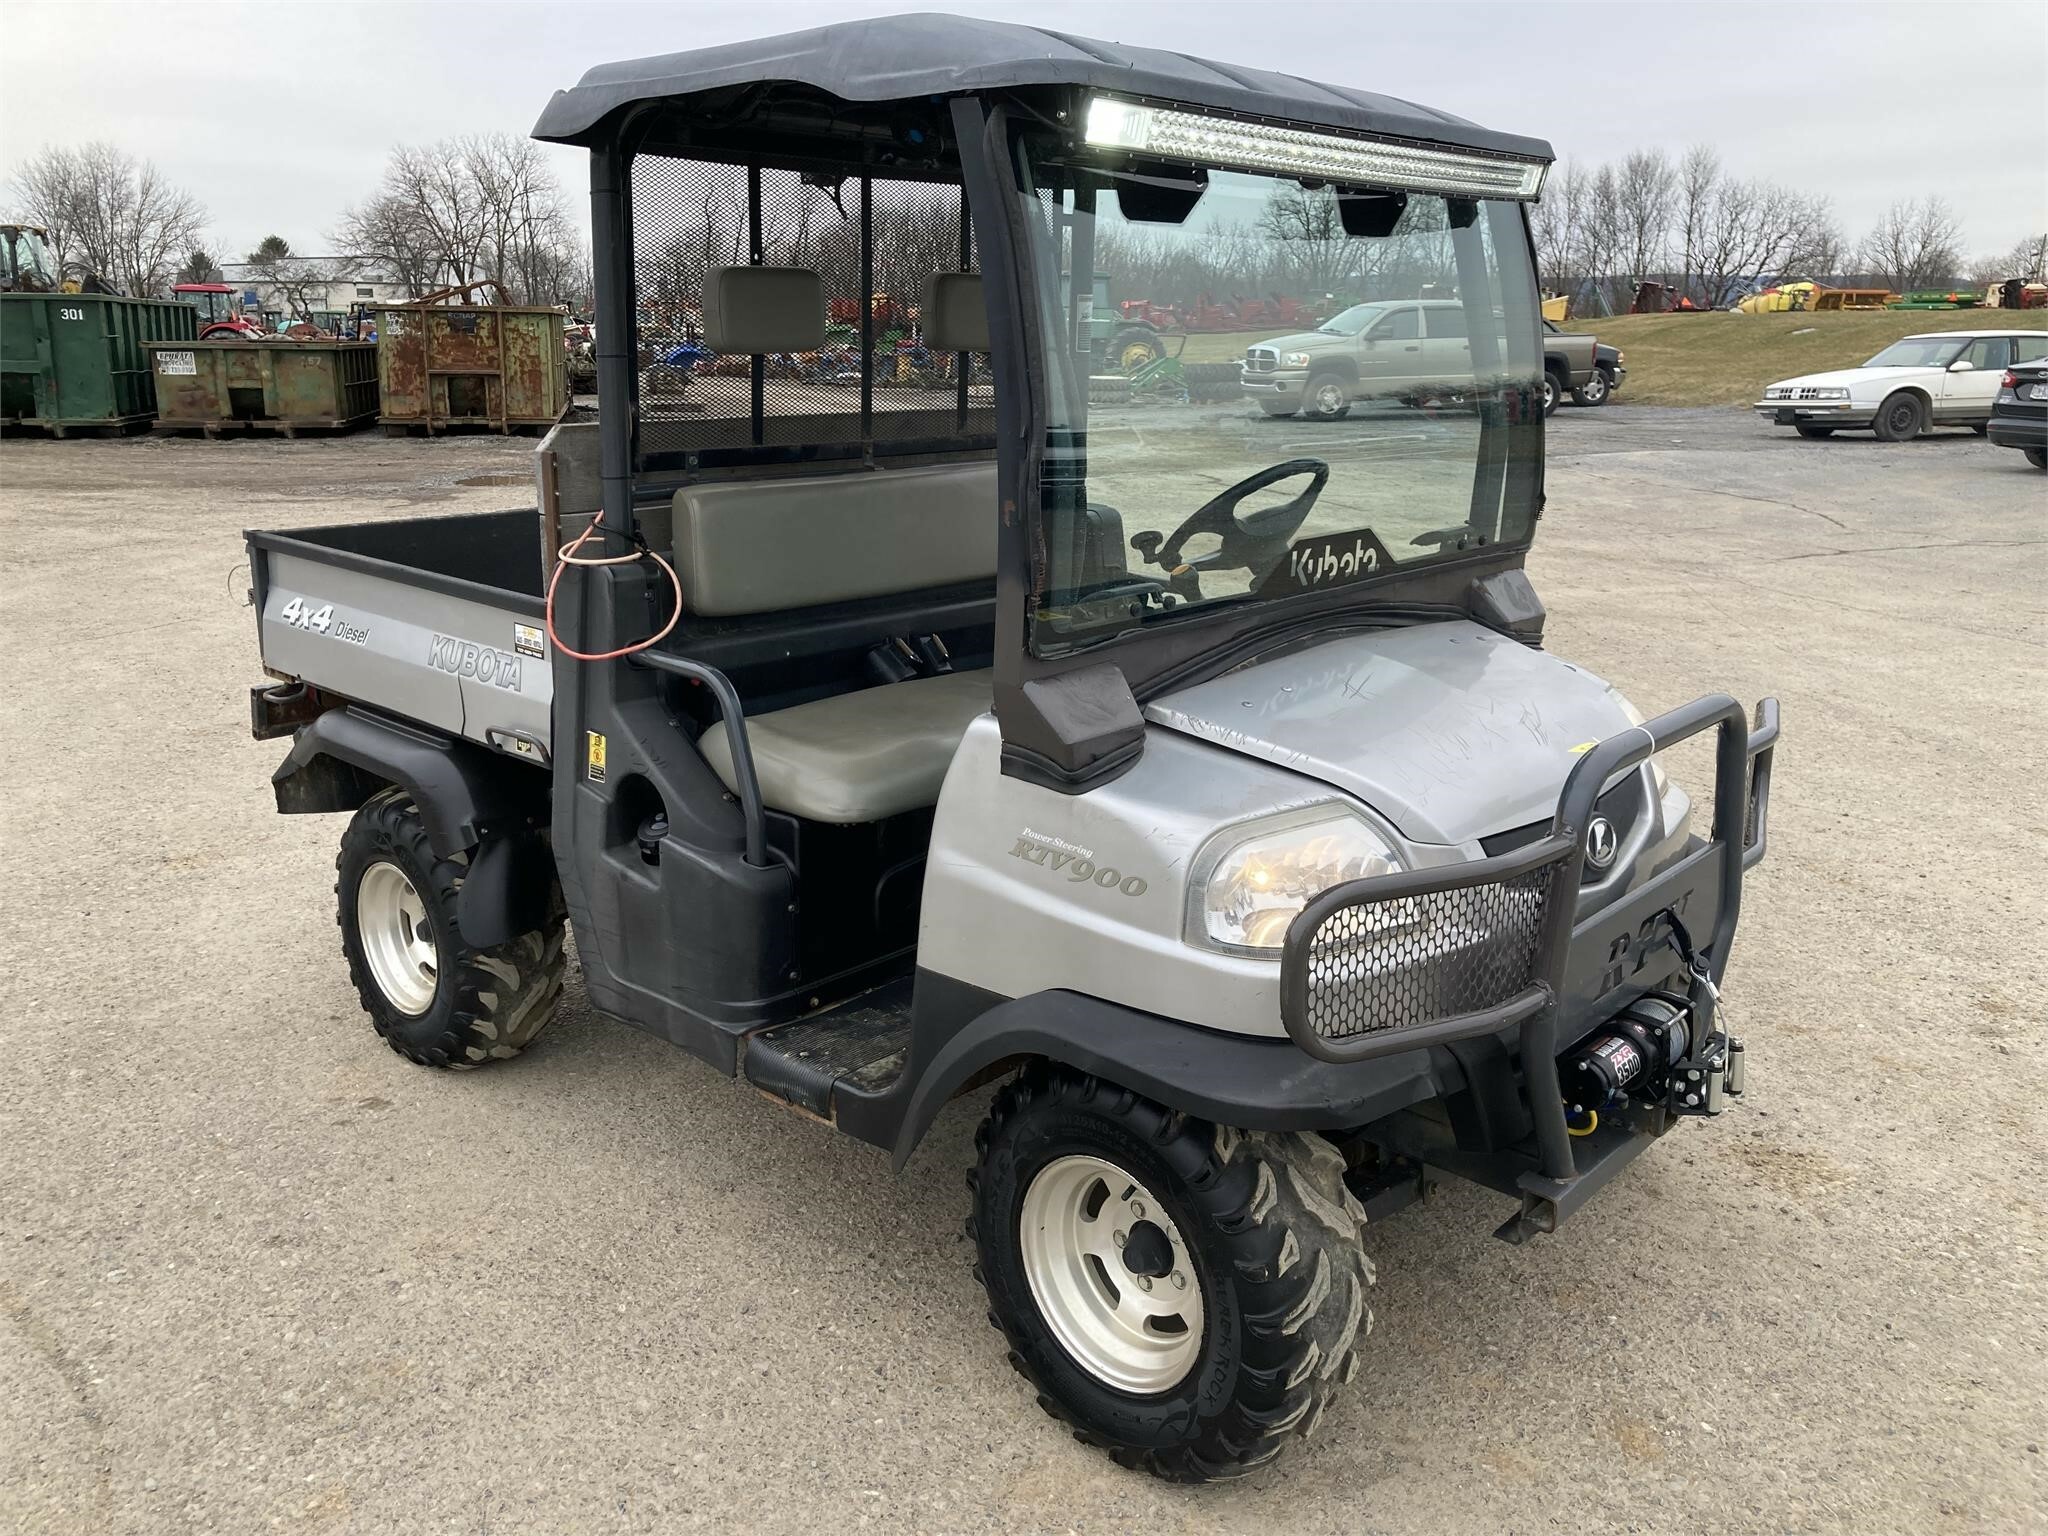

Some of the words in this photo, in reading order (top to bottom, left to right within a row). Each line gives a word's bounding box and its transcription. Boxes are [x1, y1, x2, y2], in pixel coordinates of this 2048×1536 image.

[60, 308, 83, 320] 301
[1290, 539, 1378, 586] Kubota
[281, 597, 334, 634] 4x4
[334, 621, 370, 646] Diesel
[427, 634, 522, 692] KUBOTA
[1022, 827, 1052, 844] Power
[1052, 837, 1094, 859] Steering
[1008, 837, 1148, 897] RTV900
[1611, 1046, 1633, 1067] ZXR
[1616, 1054, 1641, 1085] 3500
